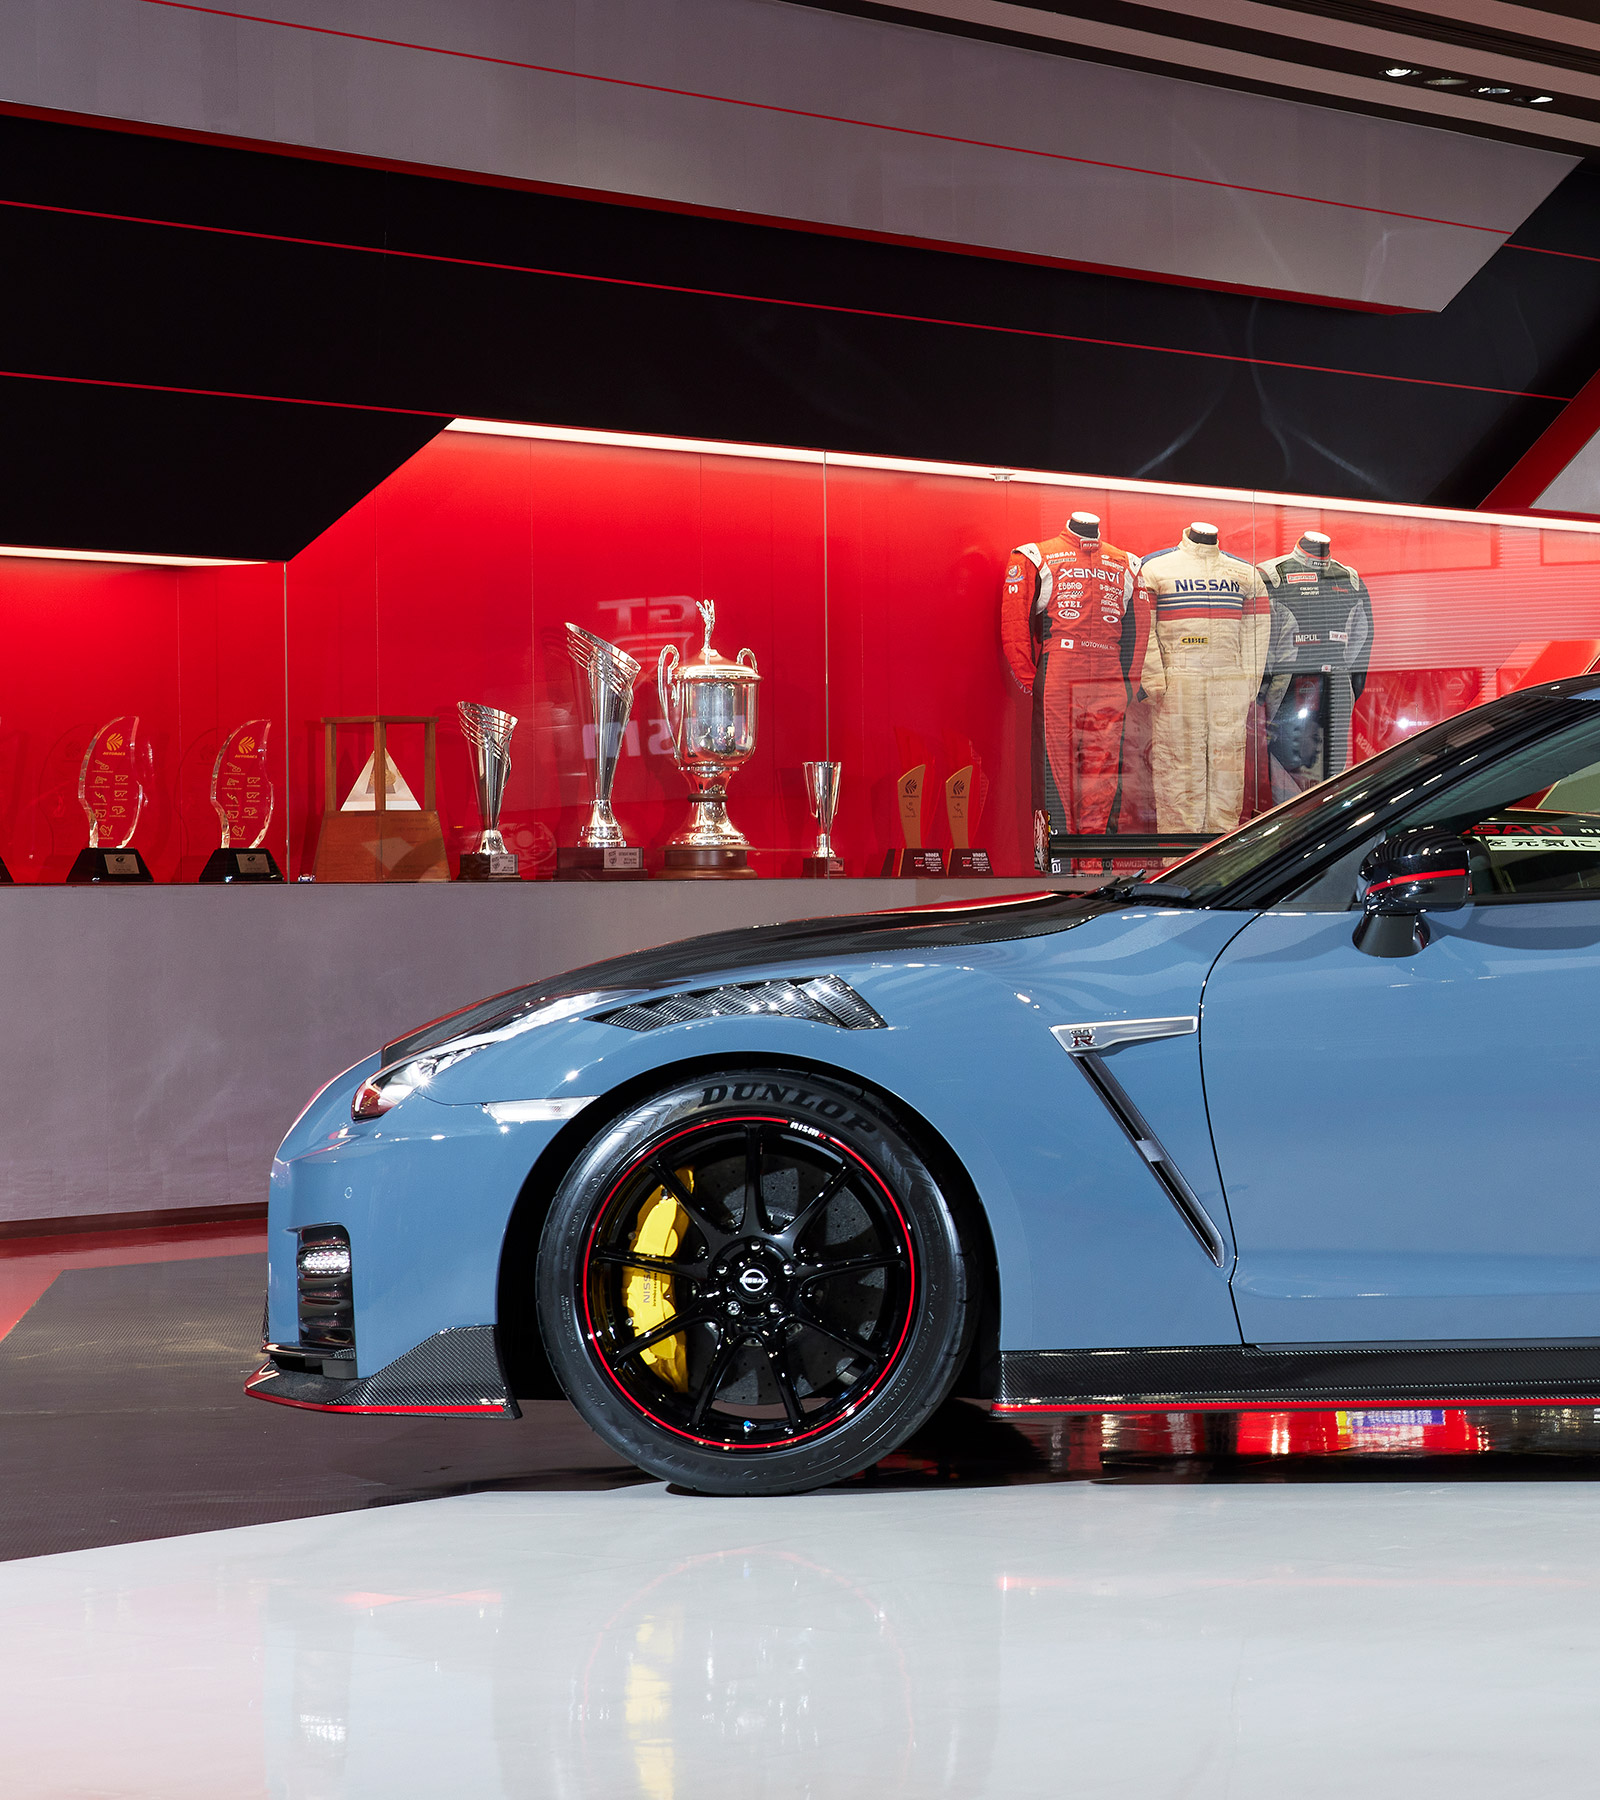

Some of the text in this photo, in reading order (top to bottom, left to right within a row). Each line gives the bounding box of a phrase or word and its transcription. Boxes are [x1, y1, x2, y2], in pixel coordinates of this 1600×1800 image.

[1046, 551, 1076, 560] NISSAN
[1175, 579, 1240, 593] NISSAN
[1295, 634, 1321, 643] IMPUL
[697, 1082, 878, 1136] DUNLOP
[790, 1121, 826, 1139] nismo
[643, 1270, 651, 1303] NISS
